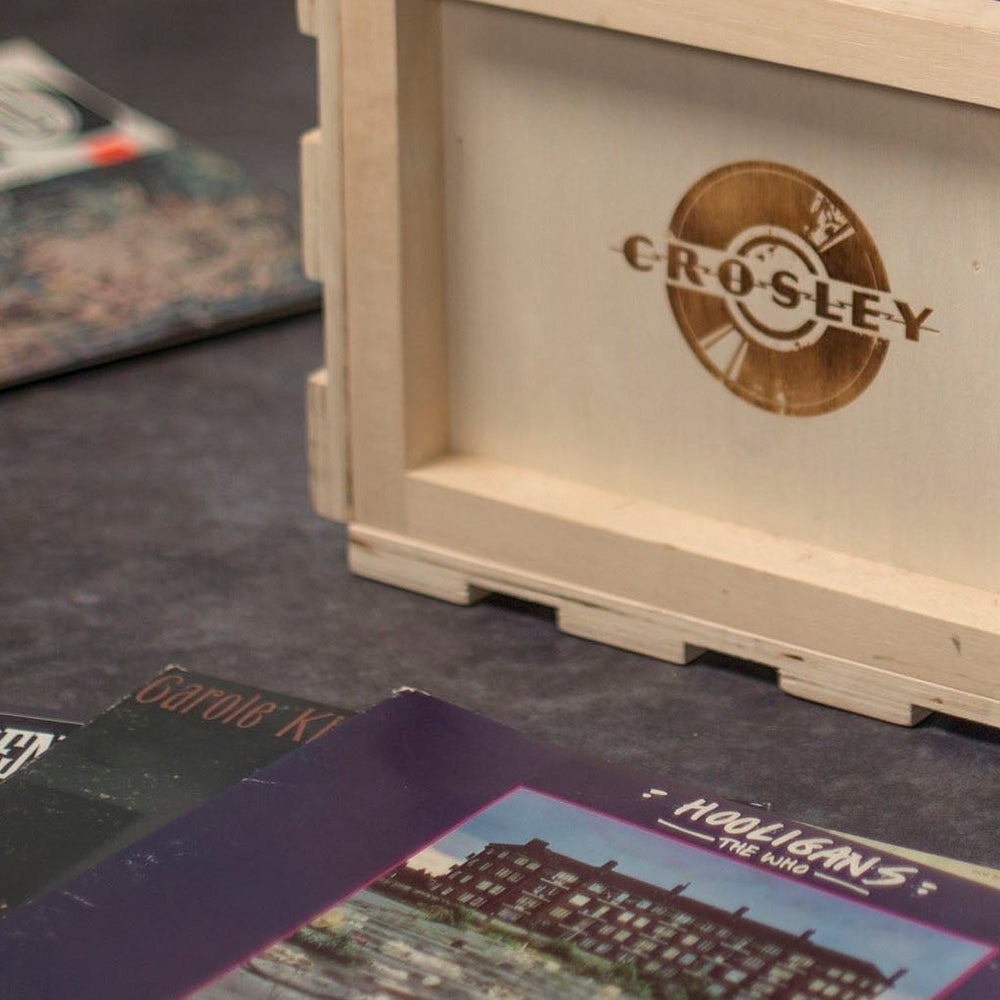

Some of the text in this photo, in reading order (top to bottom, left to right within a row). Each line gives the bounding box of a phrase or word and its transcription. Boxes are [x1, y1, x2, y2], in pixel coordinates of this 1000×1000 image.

[622, 234, 934, 342] CROSLEY
[274, 707, 345, 745] KI
[0, 727, 67, 779] EN
[673, 798, 918, 886] HOOLIGANS
[718, 836, 810, 875] THE WHO
